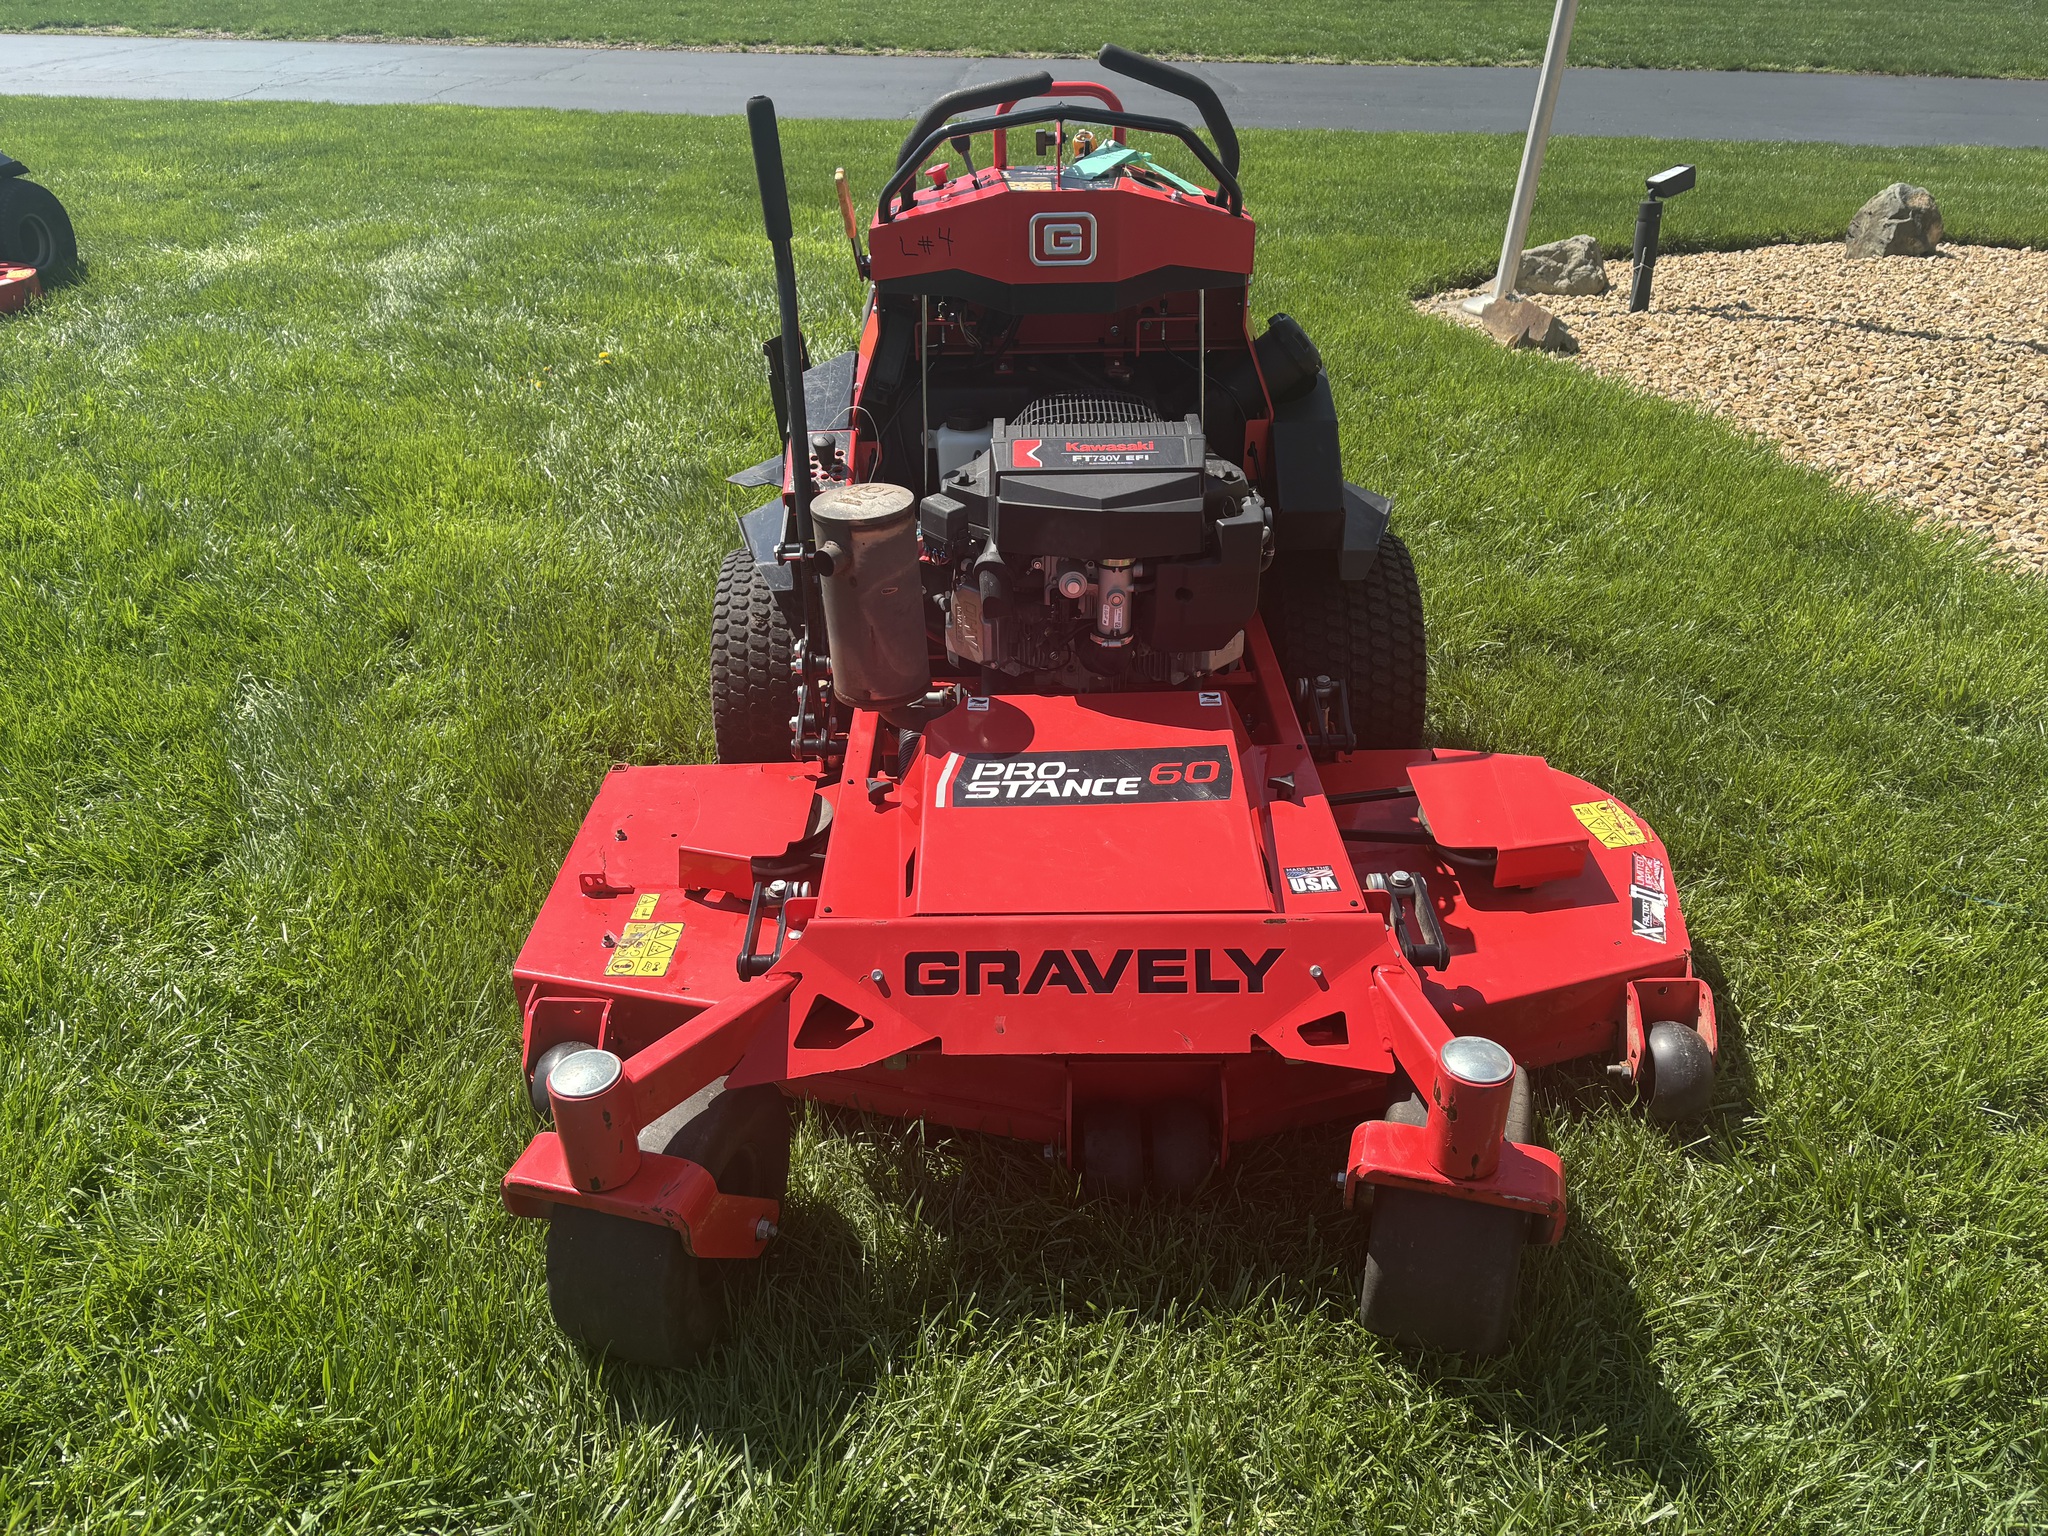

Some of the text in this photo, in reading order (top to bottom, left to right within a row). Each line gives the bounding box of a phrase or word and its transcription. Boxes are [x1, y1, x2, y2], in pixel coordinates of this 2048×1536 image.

[1044, 223, 1082, 255] G
[1065, 441, 1155, 452] Kawasaki
[1072, 454, 1121, 462] FT730V
[971, 761, 1080, 781] PRO-
[1149, 760, 1221, 785] 60
[964, 776, 1142, 799] STANCE
[1636, 855, 1645, 886] LIMITED
[1289, 876, 1338, 892] USA
[904, 948, 1286, 996] GRAVELY
